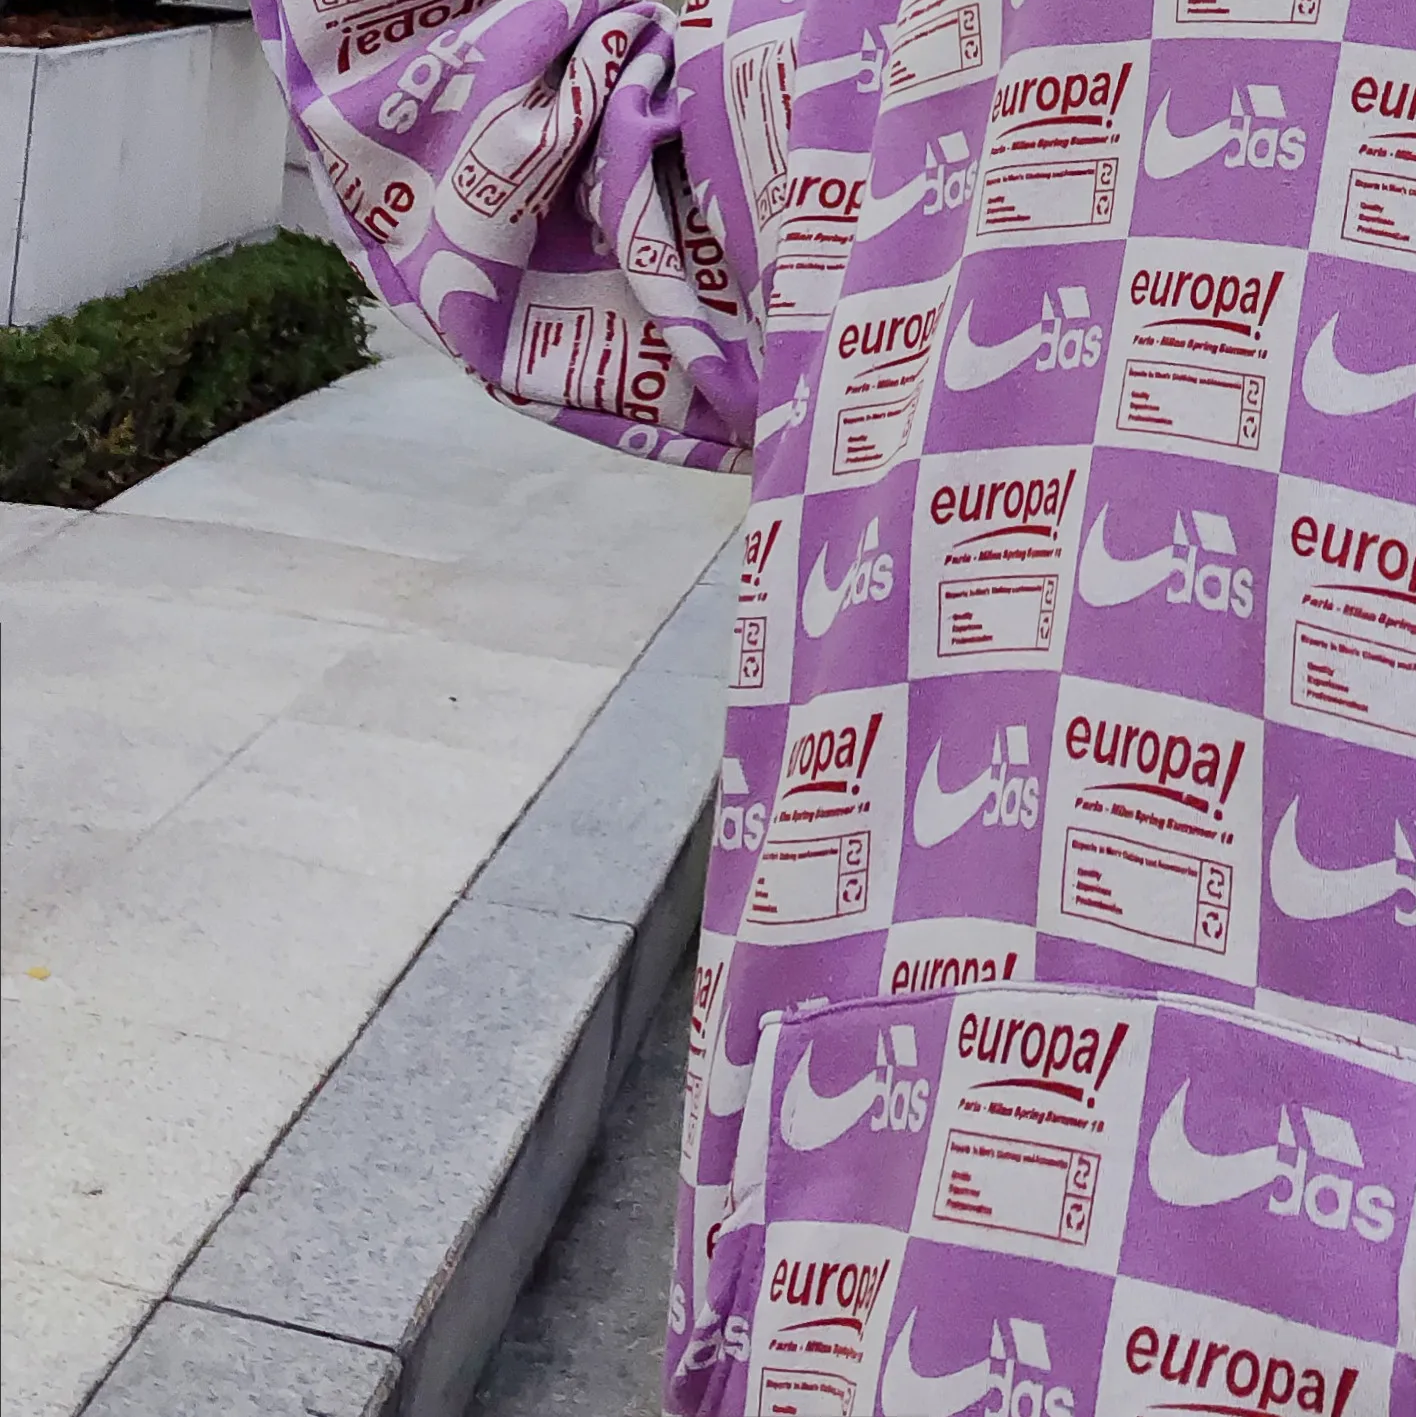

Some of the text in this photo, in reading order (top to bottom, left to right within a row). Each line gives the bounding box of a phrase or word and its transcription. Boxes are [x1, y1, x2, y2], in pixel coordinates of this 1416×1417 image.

[991, 62, 1133, 129] europa!
[1224, 117, 1307, 170] das
[1358, 144, 1387, 157] Paris
[1130, 269, 1285, 341] europa!
[1035, 318, 1103, 371] das
[930, 468, 1077, 541] europa!
[1166, 545, 1254, 618] das
[982, 763, 1040, 830] das
[1065, 715, 1246, 821] europa!
[958, 1012, 1129, 1109] europa!
[870, 1068, 931, 1132] das
[1268, 1148, 1396, 1244] das
[1126, 1325, 1360, 1417] europa!
